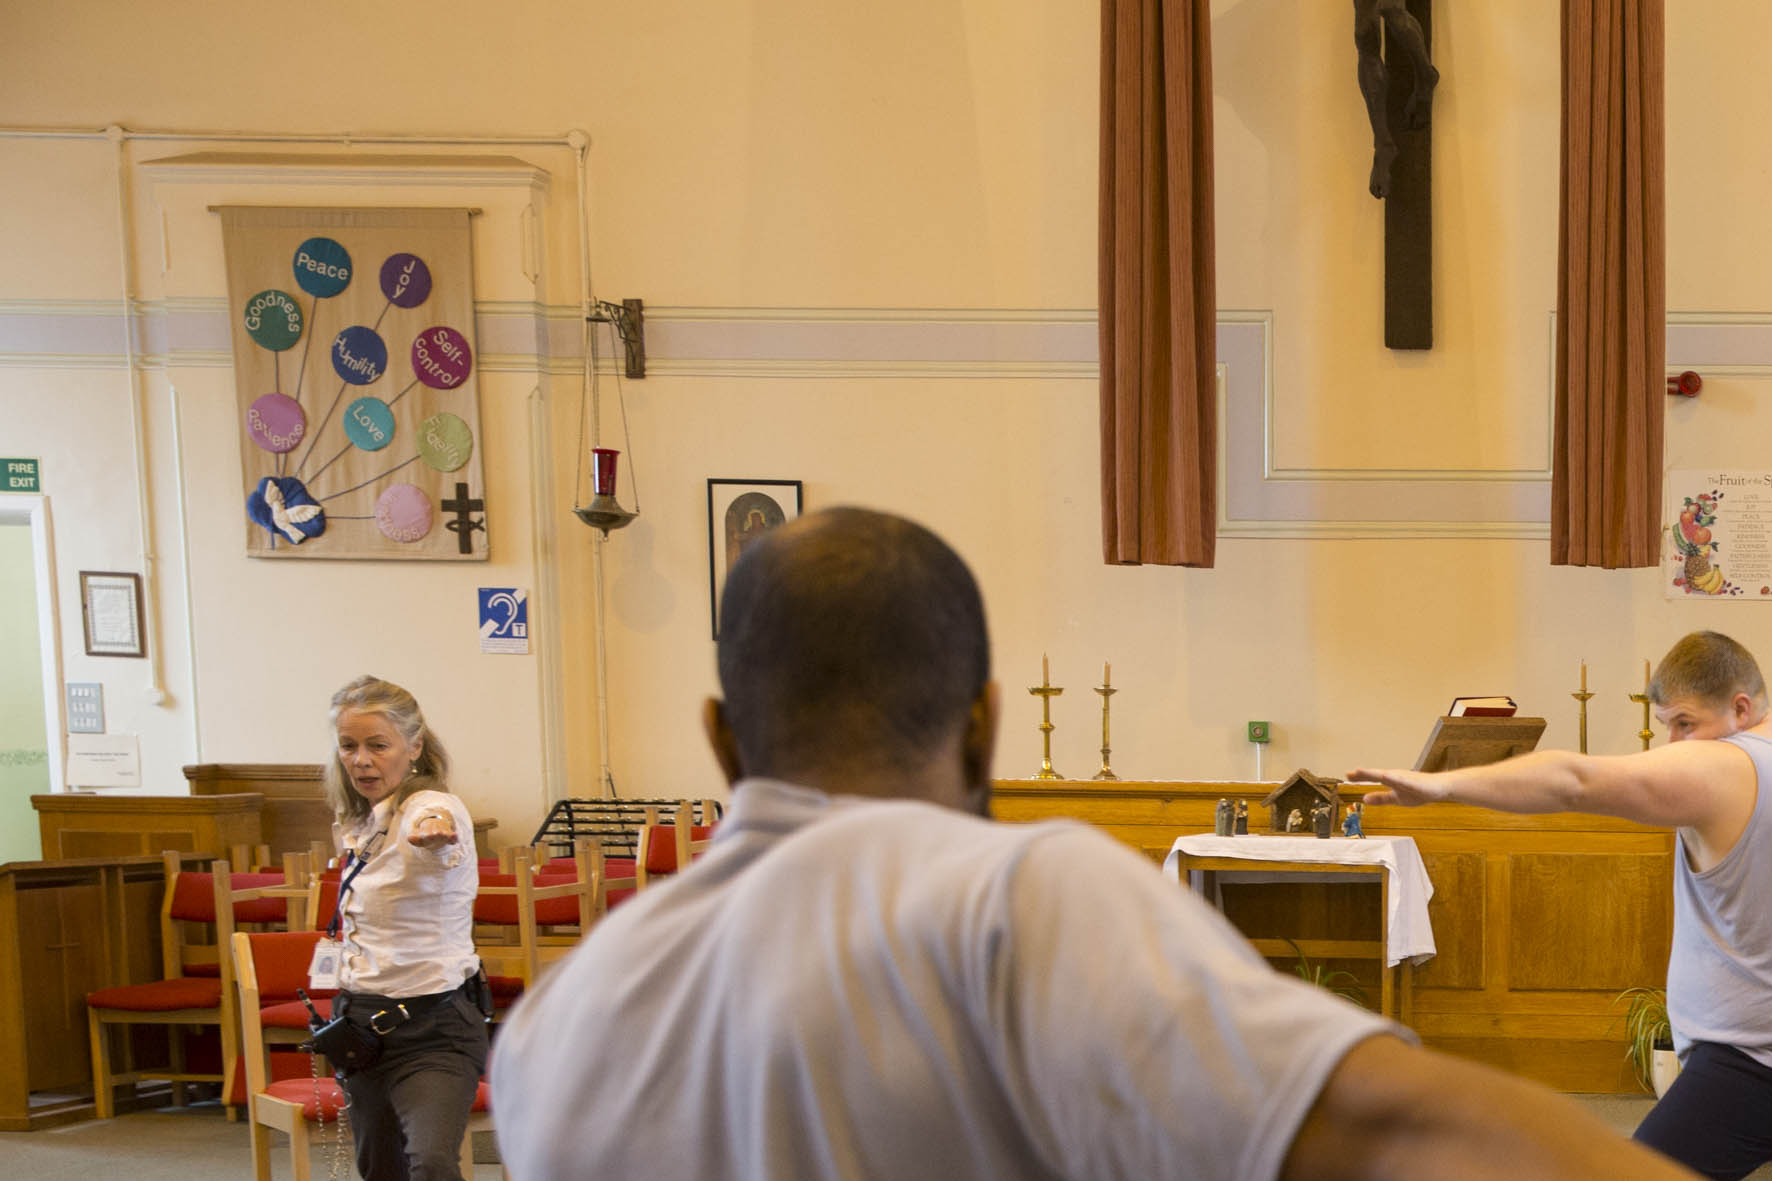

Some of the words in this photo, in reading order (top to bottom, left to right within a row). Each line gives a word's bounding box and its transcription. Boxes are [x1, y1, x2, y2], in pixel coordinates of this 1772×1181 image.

[297, 252, 349, 281] Peace
[392, 260, 416, 299] Joy
[245, 292, 300, 333] Goodness
[333, 335, 381, 383] Humility
[415, 337, 460, 387] control
[433, 330, 464, 367] Self-
[249, 408, 304, 449] Patience
[352, 405, 386, 442] Love
[8, 463, 35, 474] FIRE
[9, 477, 35, 488] EXIT
[1719, 474, 1745, 486] Fruit
